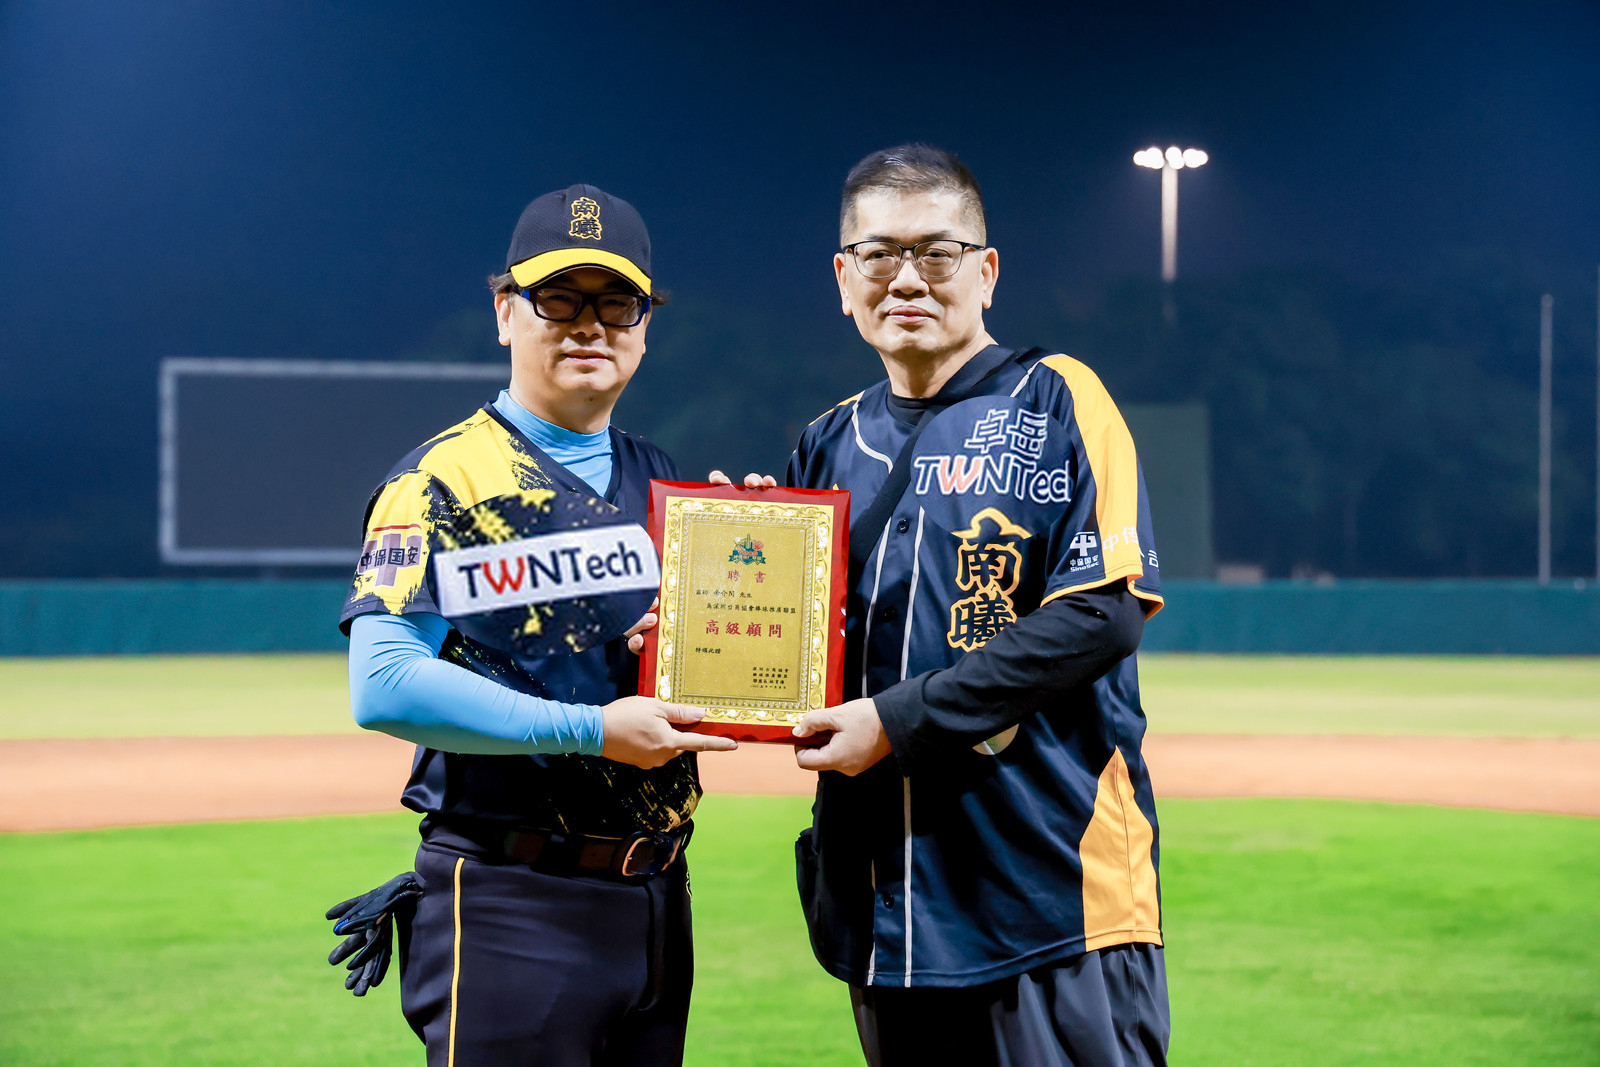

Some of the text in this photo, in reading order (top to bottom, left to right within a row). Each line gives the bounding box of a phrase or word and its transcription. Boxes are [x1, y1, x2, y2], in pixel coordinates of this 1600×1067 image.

[914, 453, 1072, 504] TWNTec
[361, 546, 418, 569] 中保国安
[458, 541, 643, 599] TWNTech
[706, 620, 782, 639] 高級顧問
